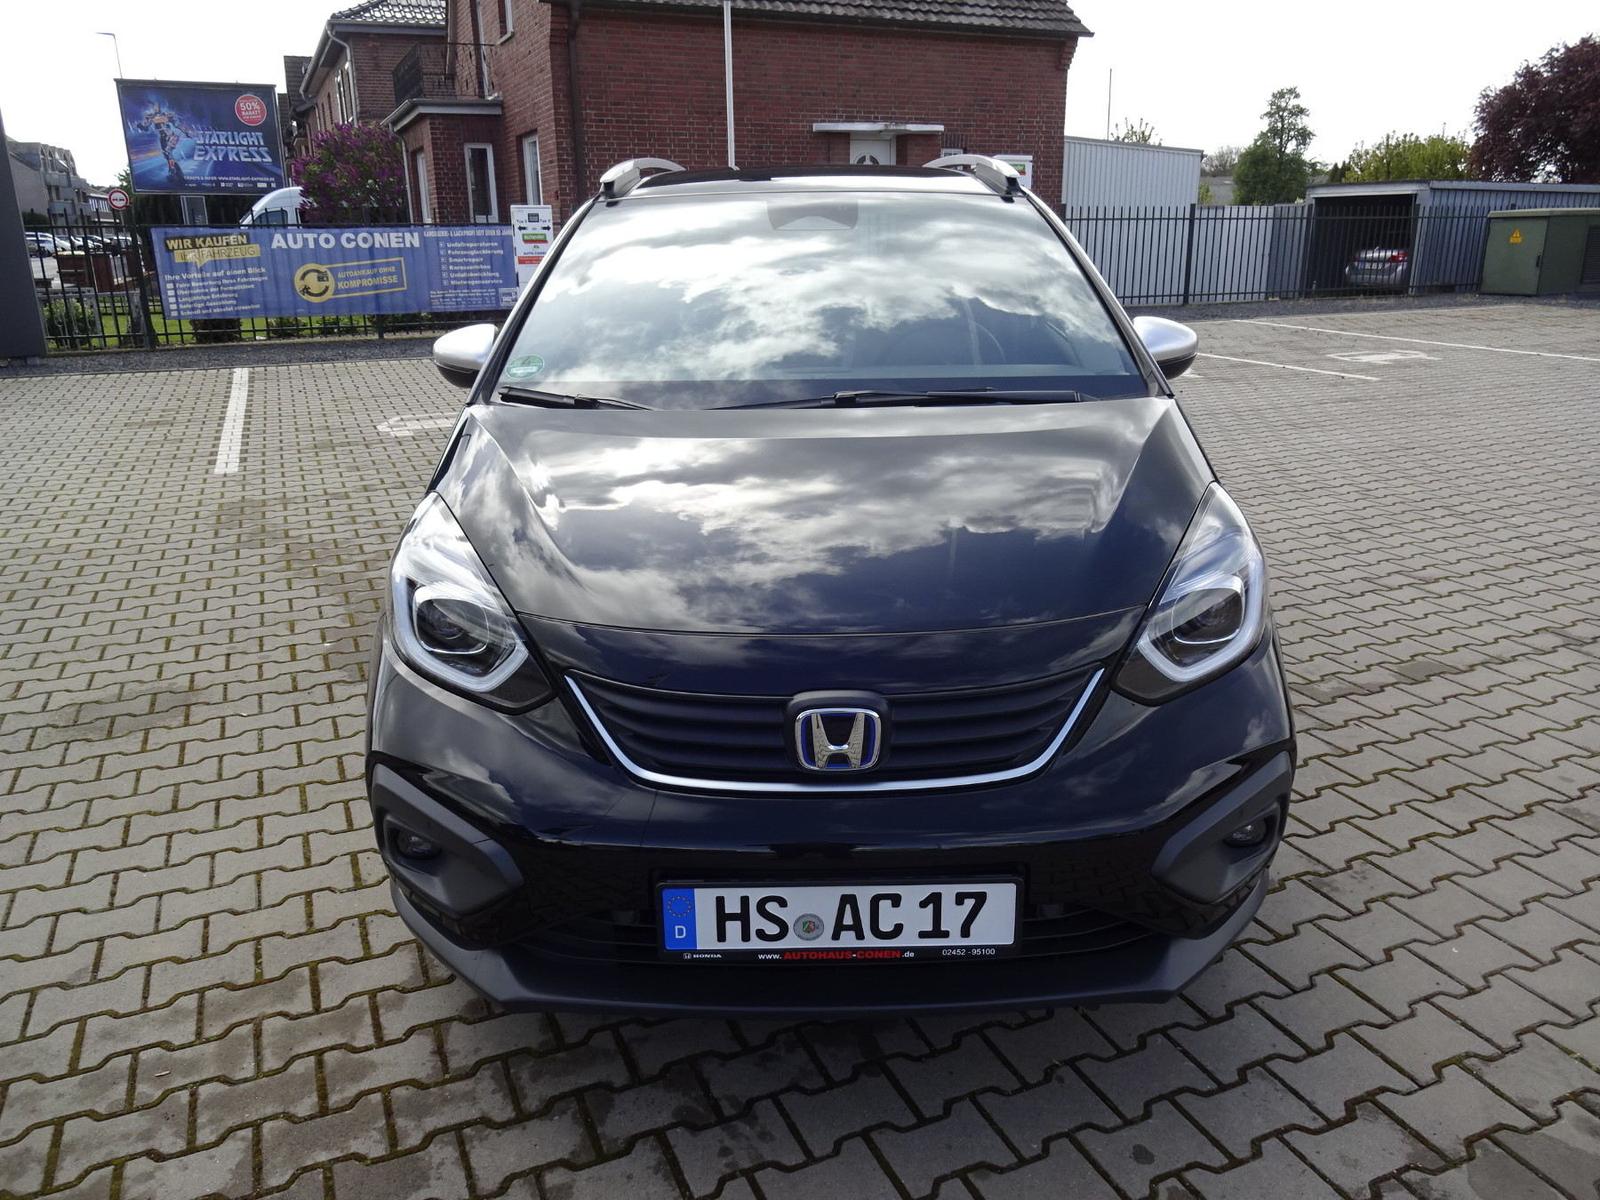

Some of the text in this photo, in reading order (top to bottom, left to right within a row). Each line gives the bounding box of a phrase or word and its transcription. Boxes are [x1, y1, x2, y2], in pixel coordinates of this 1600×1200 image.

[240, 102, 260, 110] 50%
[196, 130, 264, 145] STARLIGHT
[193, 146, 272, 162] EXPRESS
[166, 234, 247, 250] WIR KAUFEN
[271, 232, 420, 249] AUTO CONEN
[201, 248, 256, 259] FAHRZEUG
[181, 272, 211, 280] Vorteile
[337, 275, 398, 289] KOMPROMISSE
[674, 891, 988, 943] D HS AC 17
